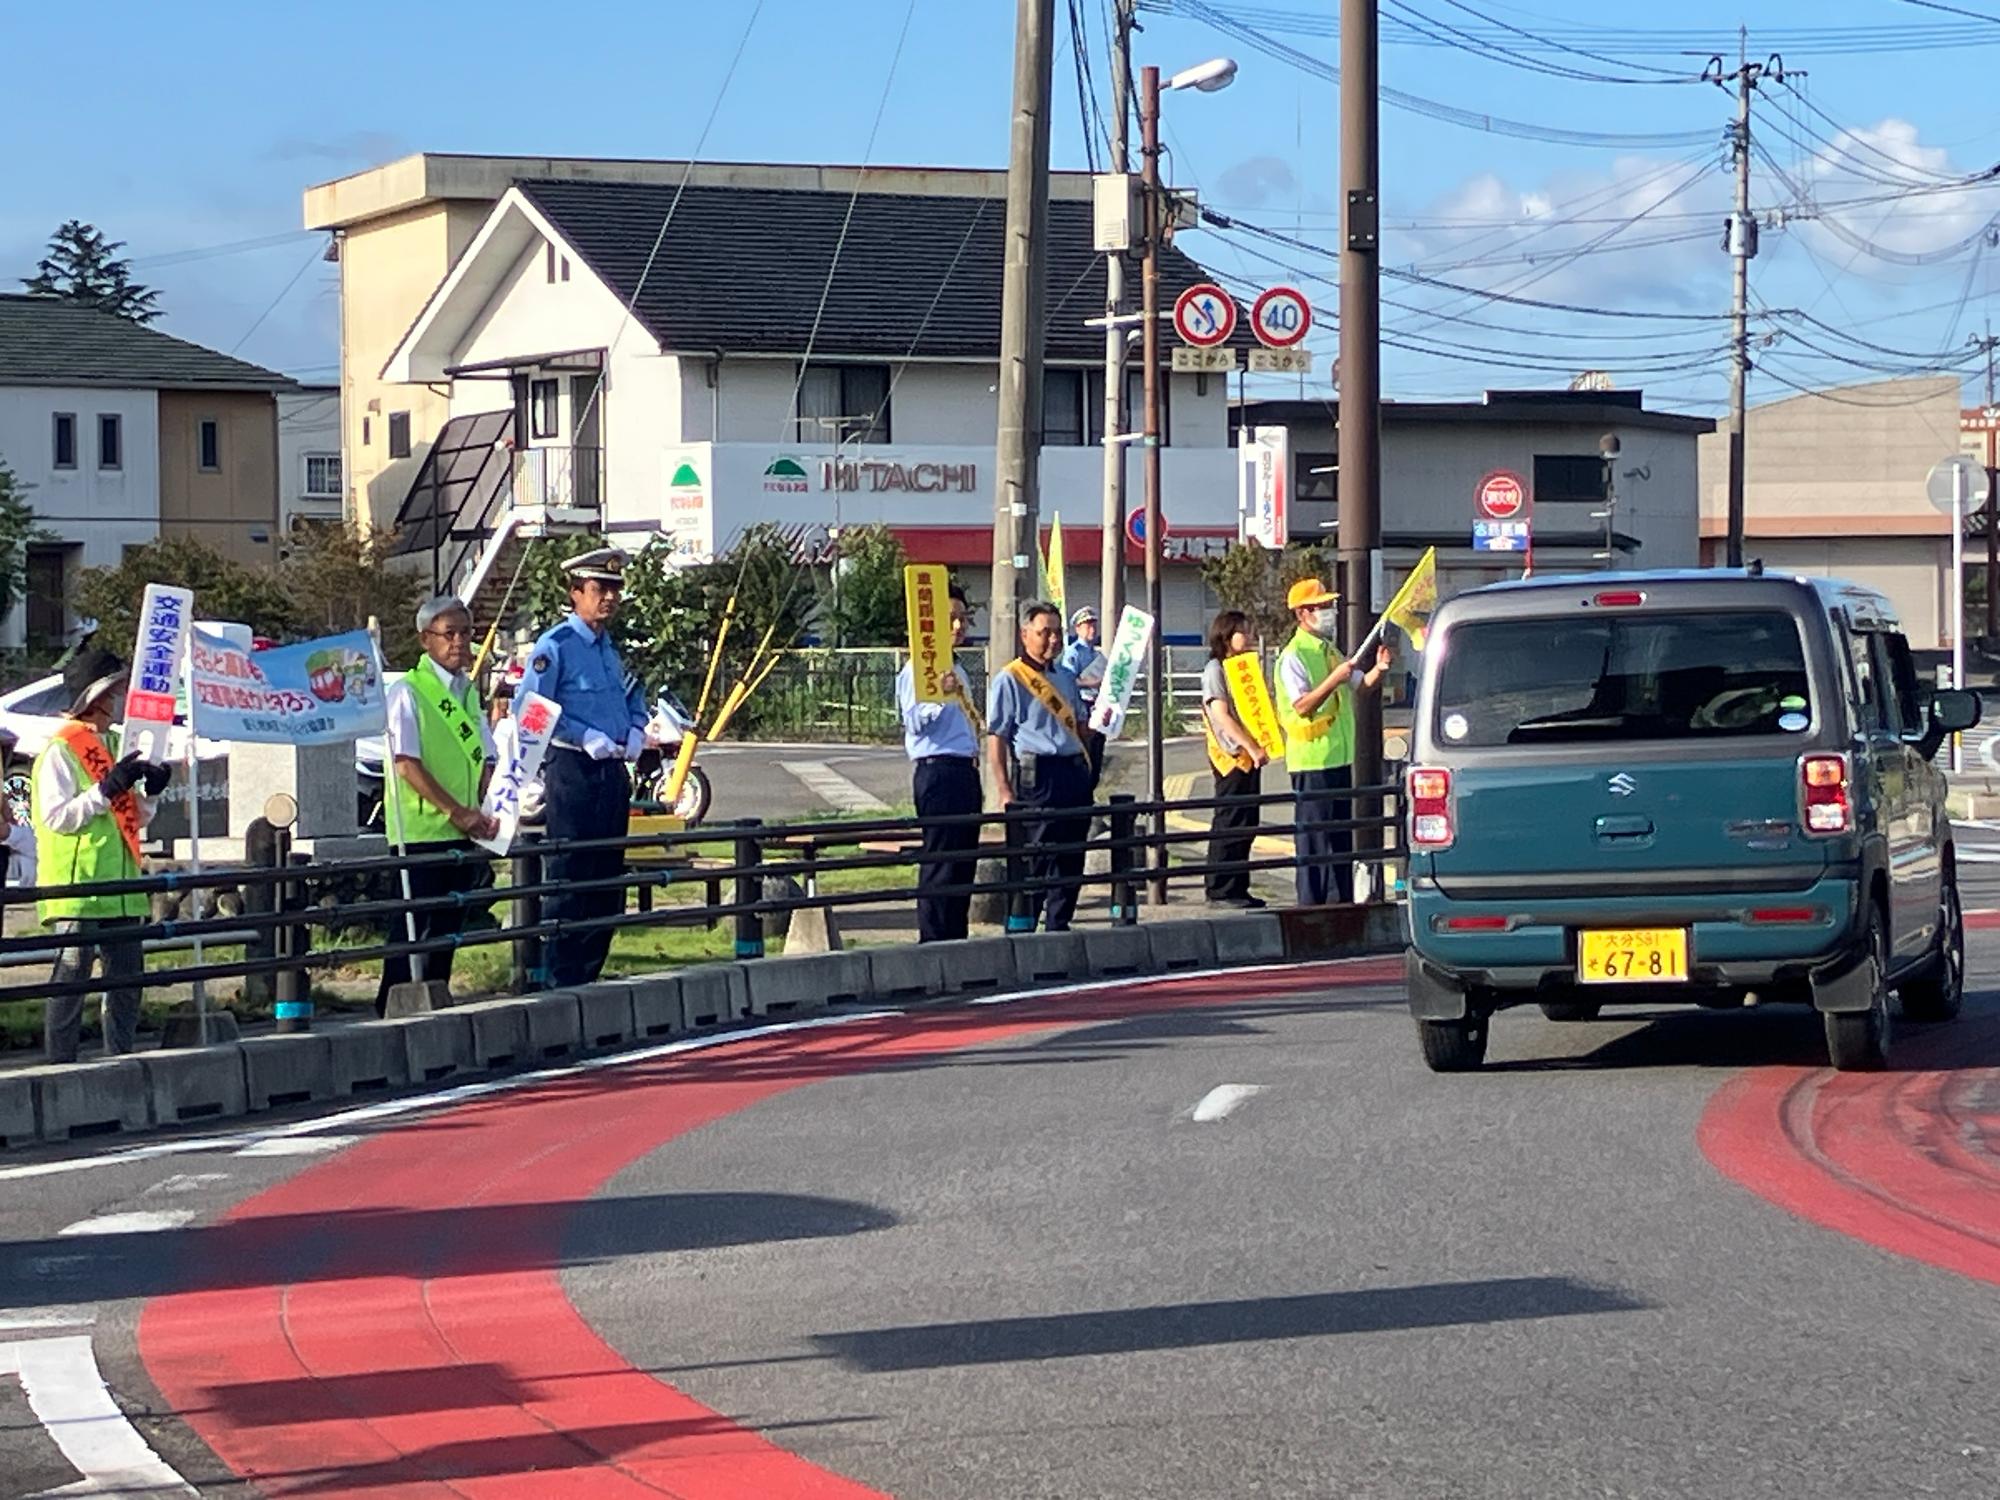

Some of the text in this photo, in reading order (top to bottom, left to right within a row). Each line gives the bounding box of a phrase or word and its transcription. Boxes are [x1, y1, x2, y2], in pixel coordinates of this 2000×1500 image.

[1266, 304, 1298, 331] 40
[1178, 354, 1229, 367] ここから
[1255, 355, 1305, 368] ここから
[819, 461, 976, 493] HITACHI
[141, 595, 183, 693] 交通安全運動
[917, 572, 938, 696] 車間距離を守ろう
[1605, 949, 1676, 976] 67-81
